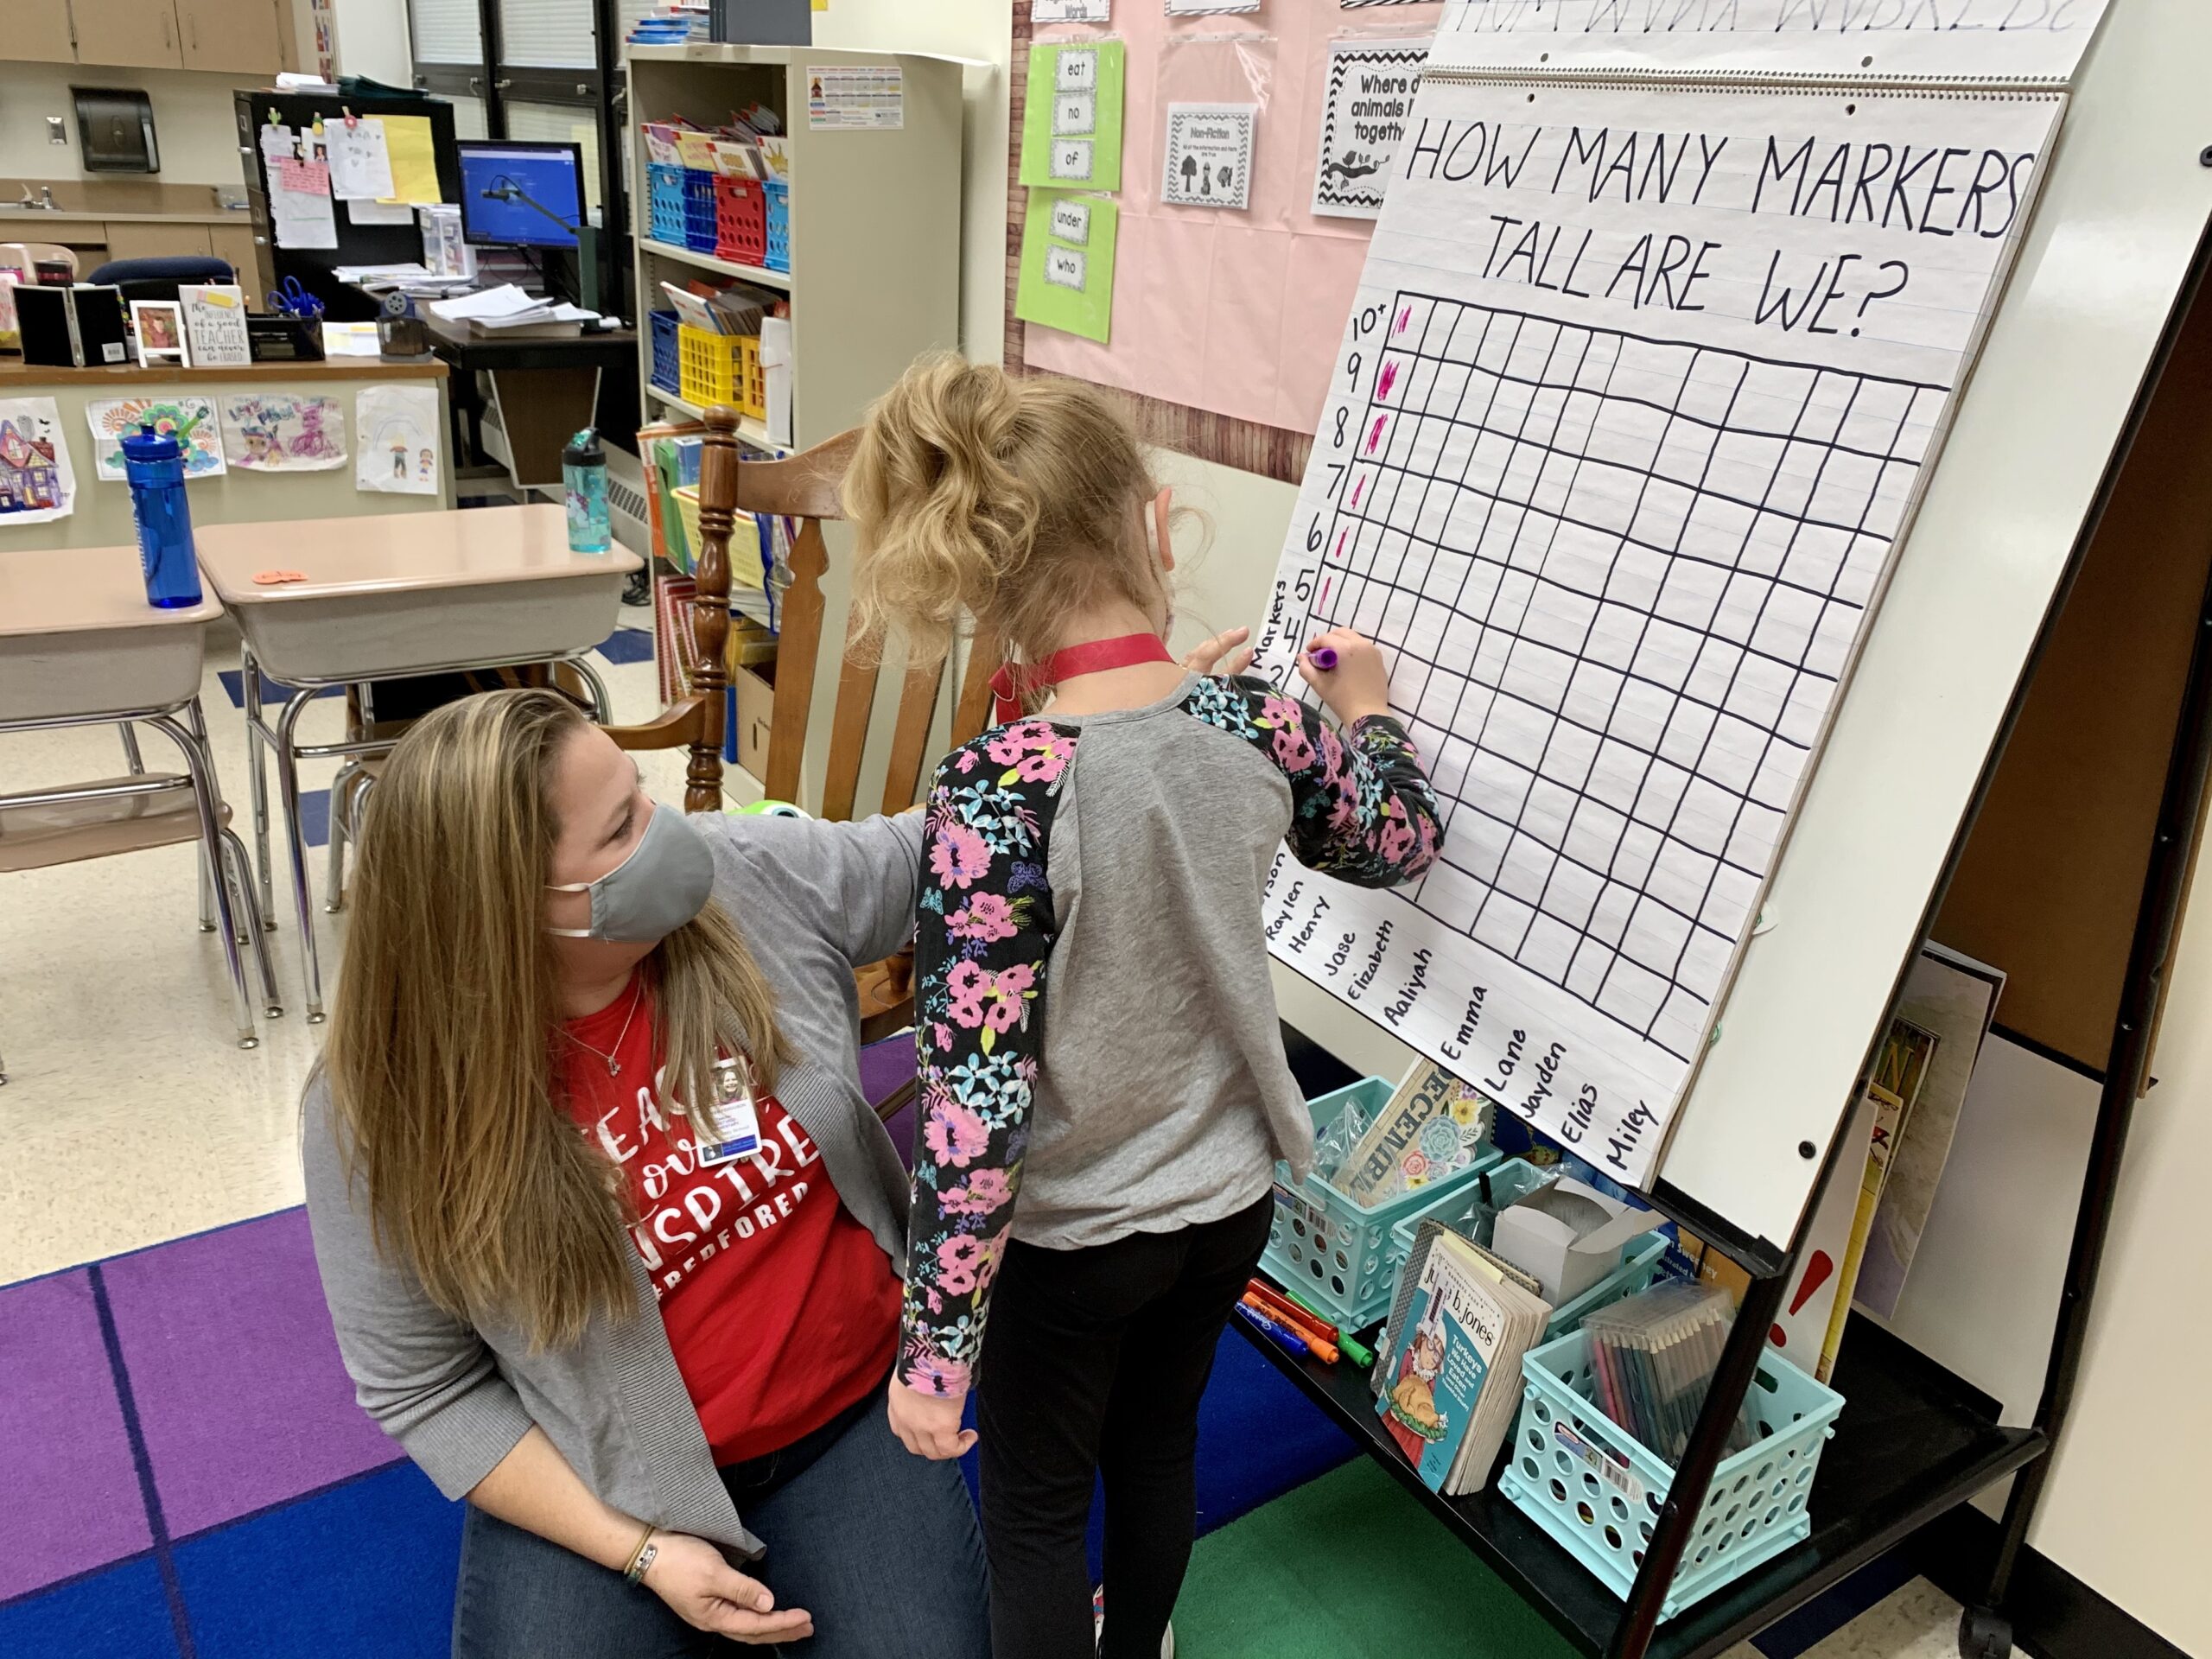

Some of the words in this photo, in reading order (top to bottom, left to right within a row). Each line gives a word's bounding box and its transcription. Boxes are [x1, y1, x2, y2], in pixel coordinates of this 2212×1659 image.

[1067, 61, 1085, 76] eat
[1361, 74, 1407, 94] Where
[1411, 74, 1421, 94] d
[1068, 105, 1079, 119] no
[1351, 99, 1404, 118] animals
[1355, 121, 1406, 145] togeth
[1065, 150, 1078, 166] of
[1406, 118, 1542, 189] HOW
[1551, 125, 1729, 206] MANY
[1751, 134, 2036, 239] MARKERS
[1057, 211, 1082, 229] under
[1057, 257, 1077, 275] who
[1482, 214, 1593, 299] TALL
[1605, 232, 1722, 311] ARE
[1754, 248, 1910, 338] WE?
[194, 329, 245, 345] TEACHER
[1347, 351, 1363, 393] 9
[1333, 405, 1349, 448] 8
[1327, 463, 1346, 499] 7
[1306, 511, 1322, 552] 6
[1294, 569, 1315, 602] 5
[1249, 580, 1287, 670] Markers
[1283, 616, 1300, 654] 4
[1265, 880, 1304, 941] Raylen
[1288, 895, 1331, 954] Henry
[1324, 931, 1357, 976] Jase
[1347, 919, 1394, 1001] Elizabeth
[1383, 947, 1433, 1027] Aaliyah
[1440, 985, 1487, 1060] Emma
[1484, 1028, 1526, 1092] Lane
[1520, 1041, 1567, 1119] Jayden
[1560, 1083, 1598, 1144] Elias
[1605, 1099, 1660, 1171] Miley
[1452, 1288, 1460, 1313] b.
[1459, 1301, 1494, 1347] jones
[1446, 1353, 1465, 1378] Loved
[1452, 1333, 1482, 1375] Turkeys
[1452, 1348, 1461, 1363] We
[1461, 1358, 1476, 1380] Have
[1448, 1367, 1466, 1392] Eaten
